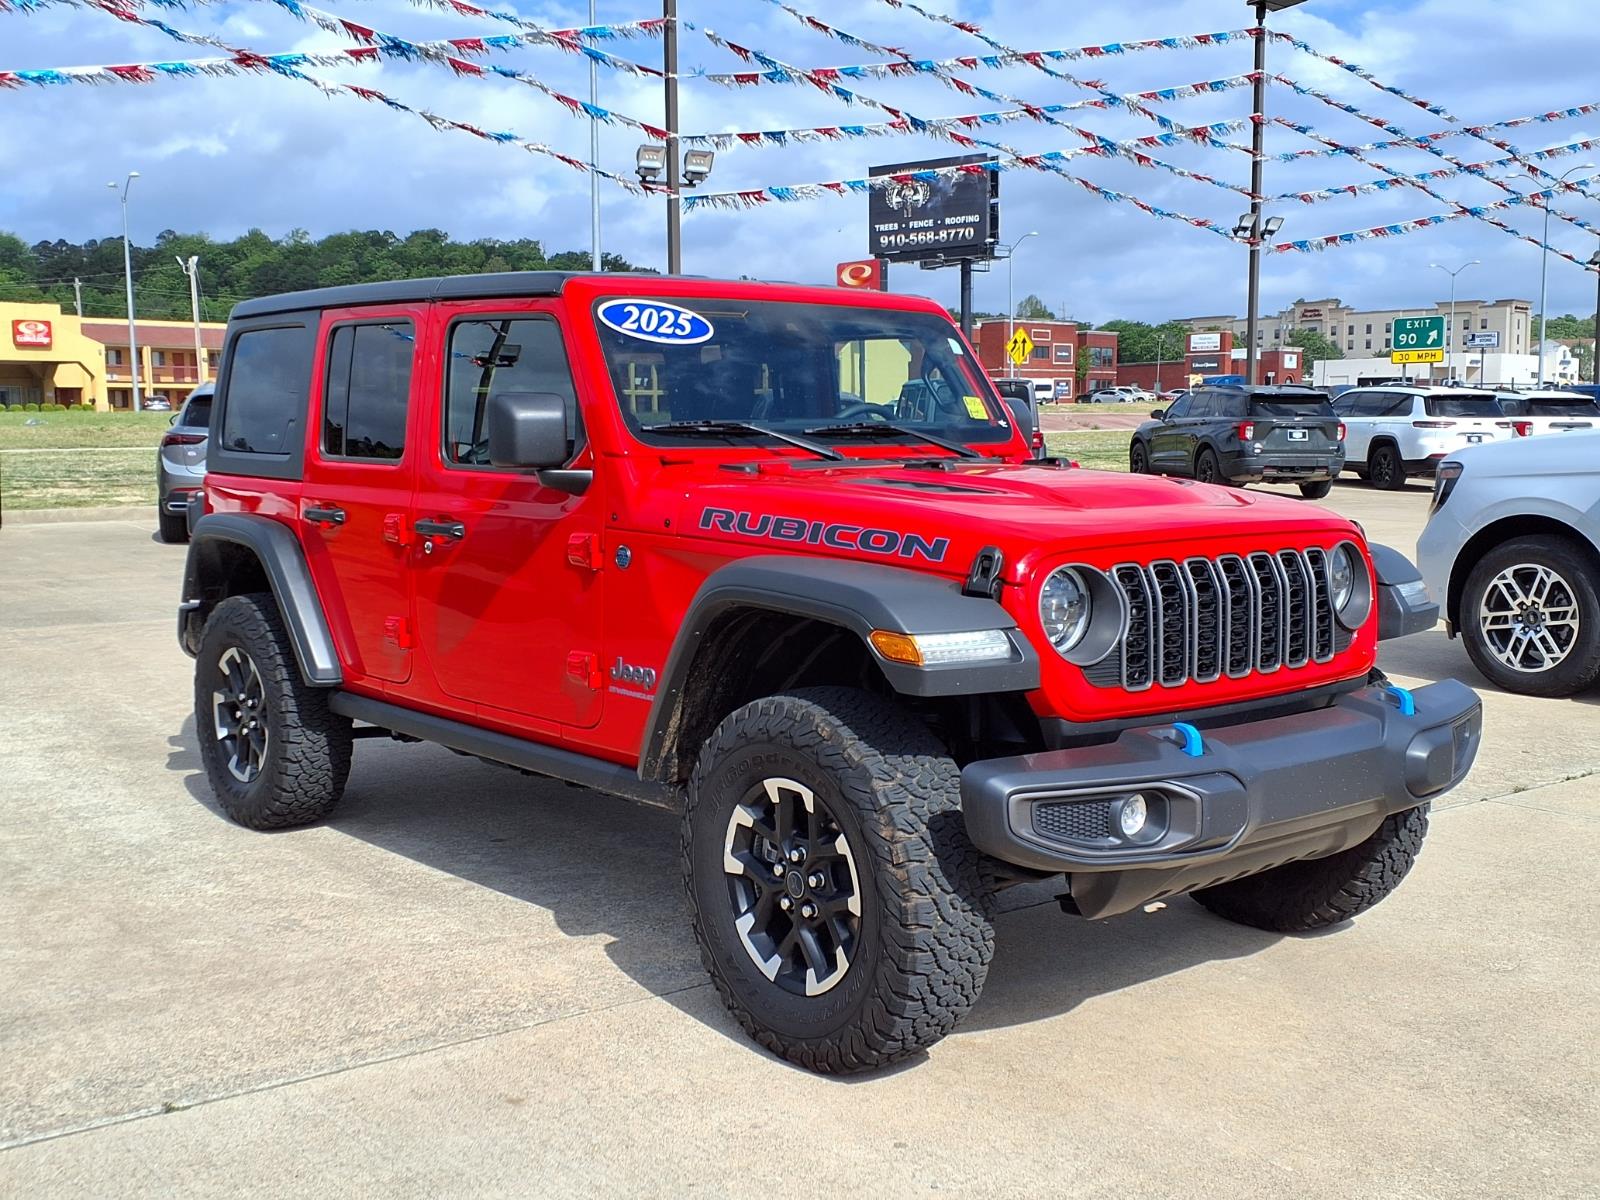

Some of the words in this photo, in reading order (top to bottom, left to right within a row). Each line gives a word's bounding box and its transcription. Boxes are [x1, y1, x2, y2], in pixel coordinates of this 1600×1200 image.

[874, 222, 899, 232] TREES
[909, 219, 934, 229] FENCE
[945, 214, 980, 225] ROOFING
[880, 227, 975, 248] 910-568-8770
[621, 305, 693, 336] 2025
[1406, 319, 1431, 329] EXIT
[1398, 333, 1417, 345] 90
[1398, 353, 1410, 361] 30
[1416, 352, 1437, 360] MPH
[698, 506, 950, 562] RUBICON
[610, 656, 656, 690] Jeep
